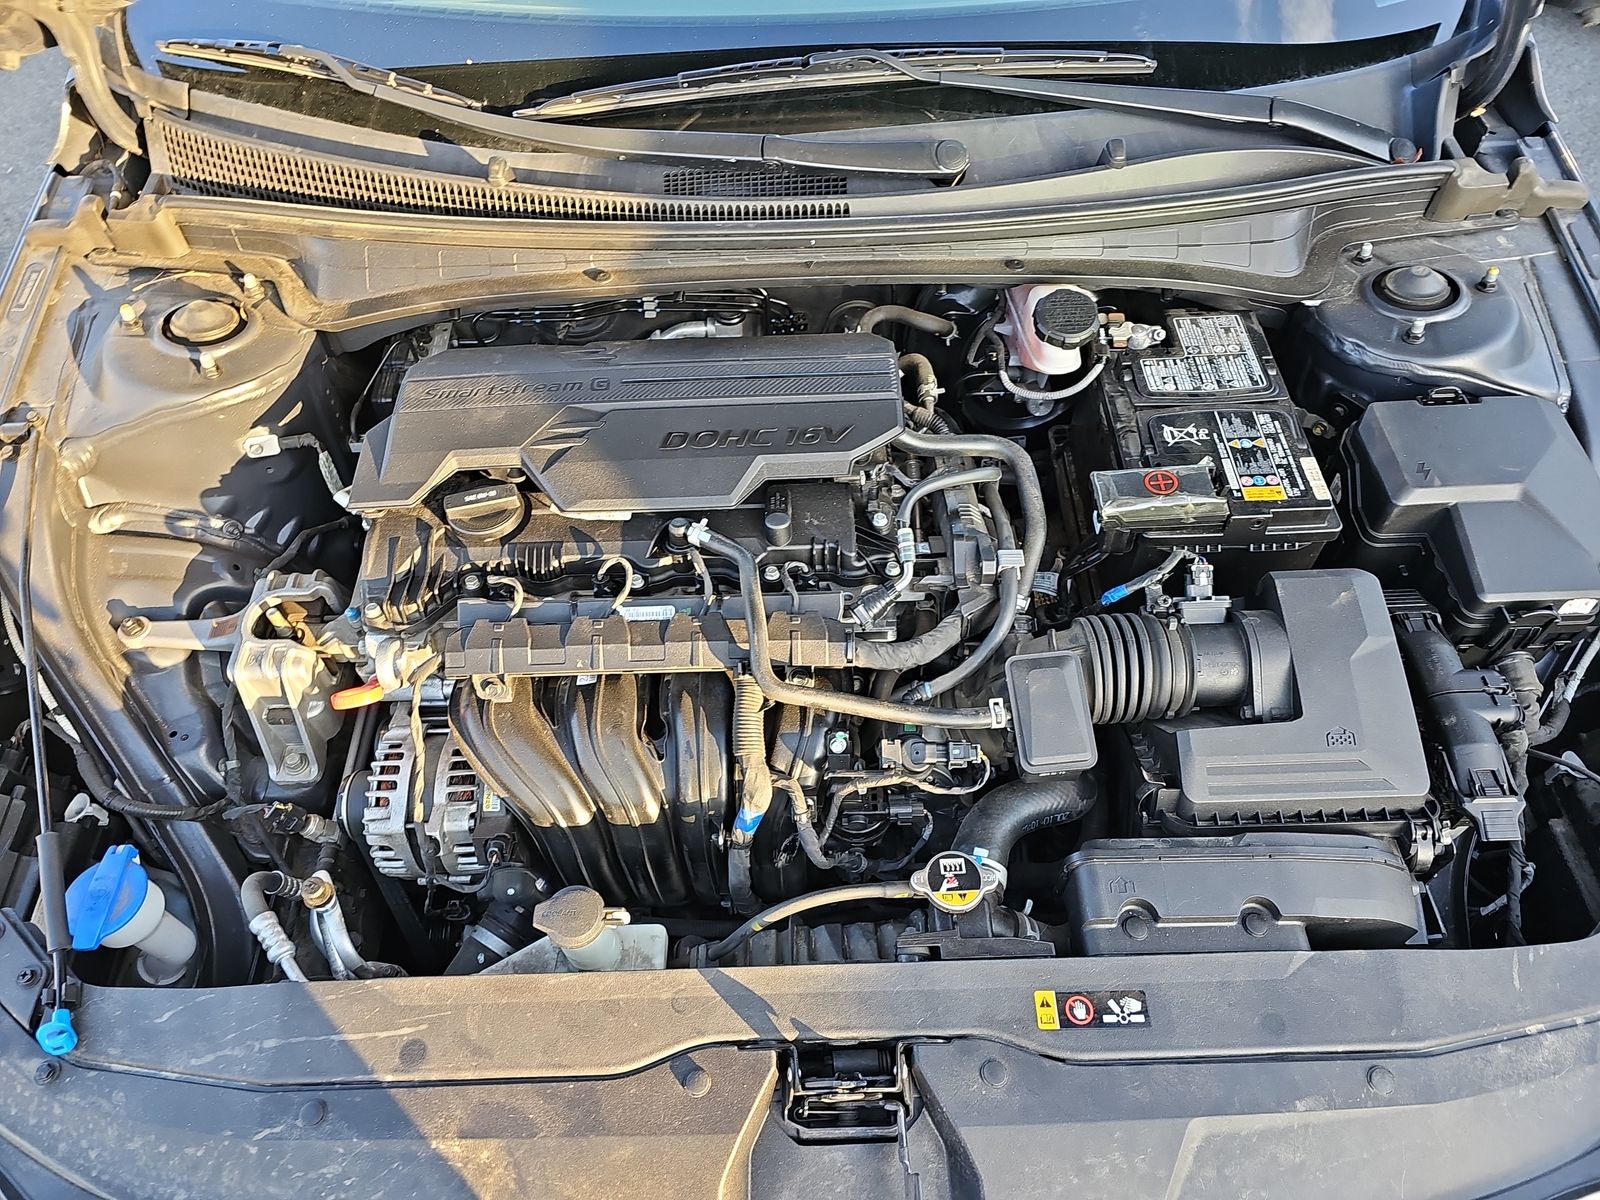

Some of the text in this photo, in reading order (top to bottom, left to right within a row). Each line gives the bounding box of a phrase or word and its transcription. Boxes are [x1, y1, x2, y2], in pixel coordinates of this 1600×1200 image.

[421, 377, 610, 400] Smartstream G
[659, 424, 855, 450] DOHC 16V
